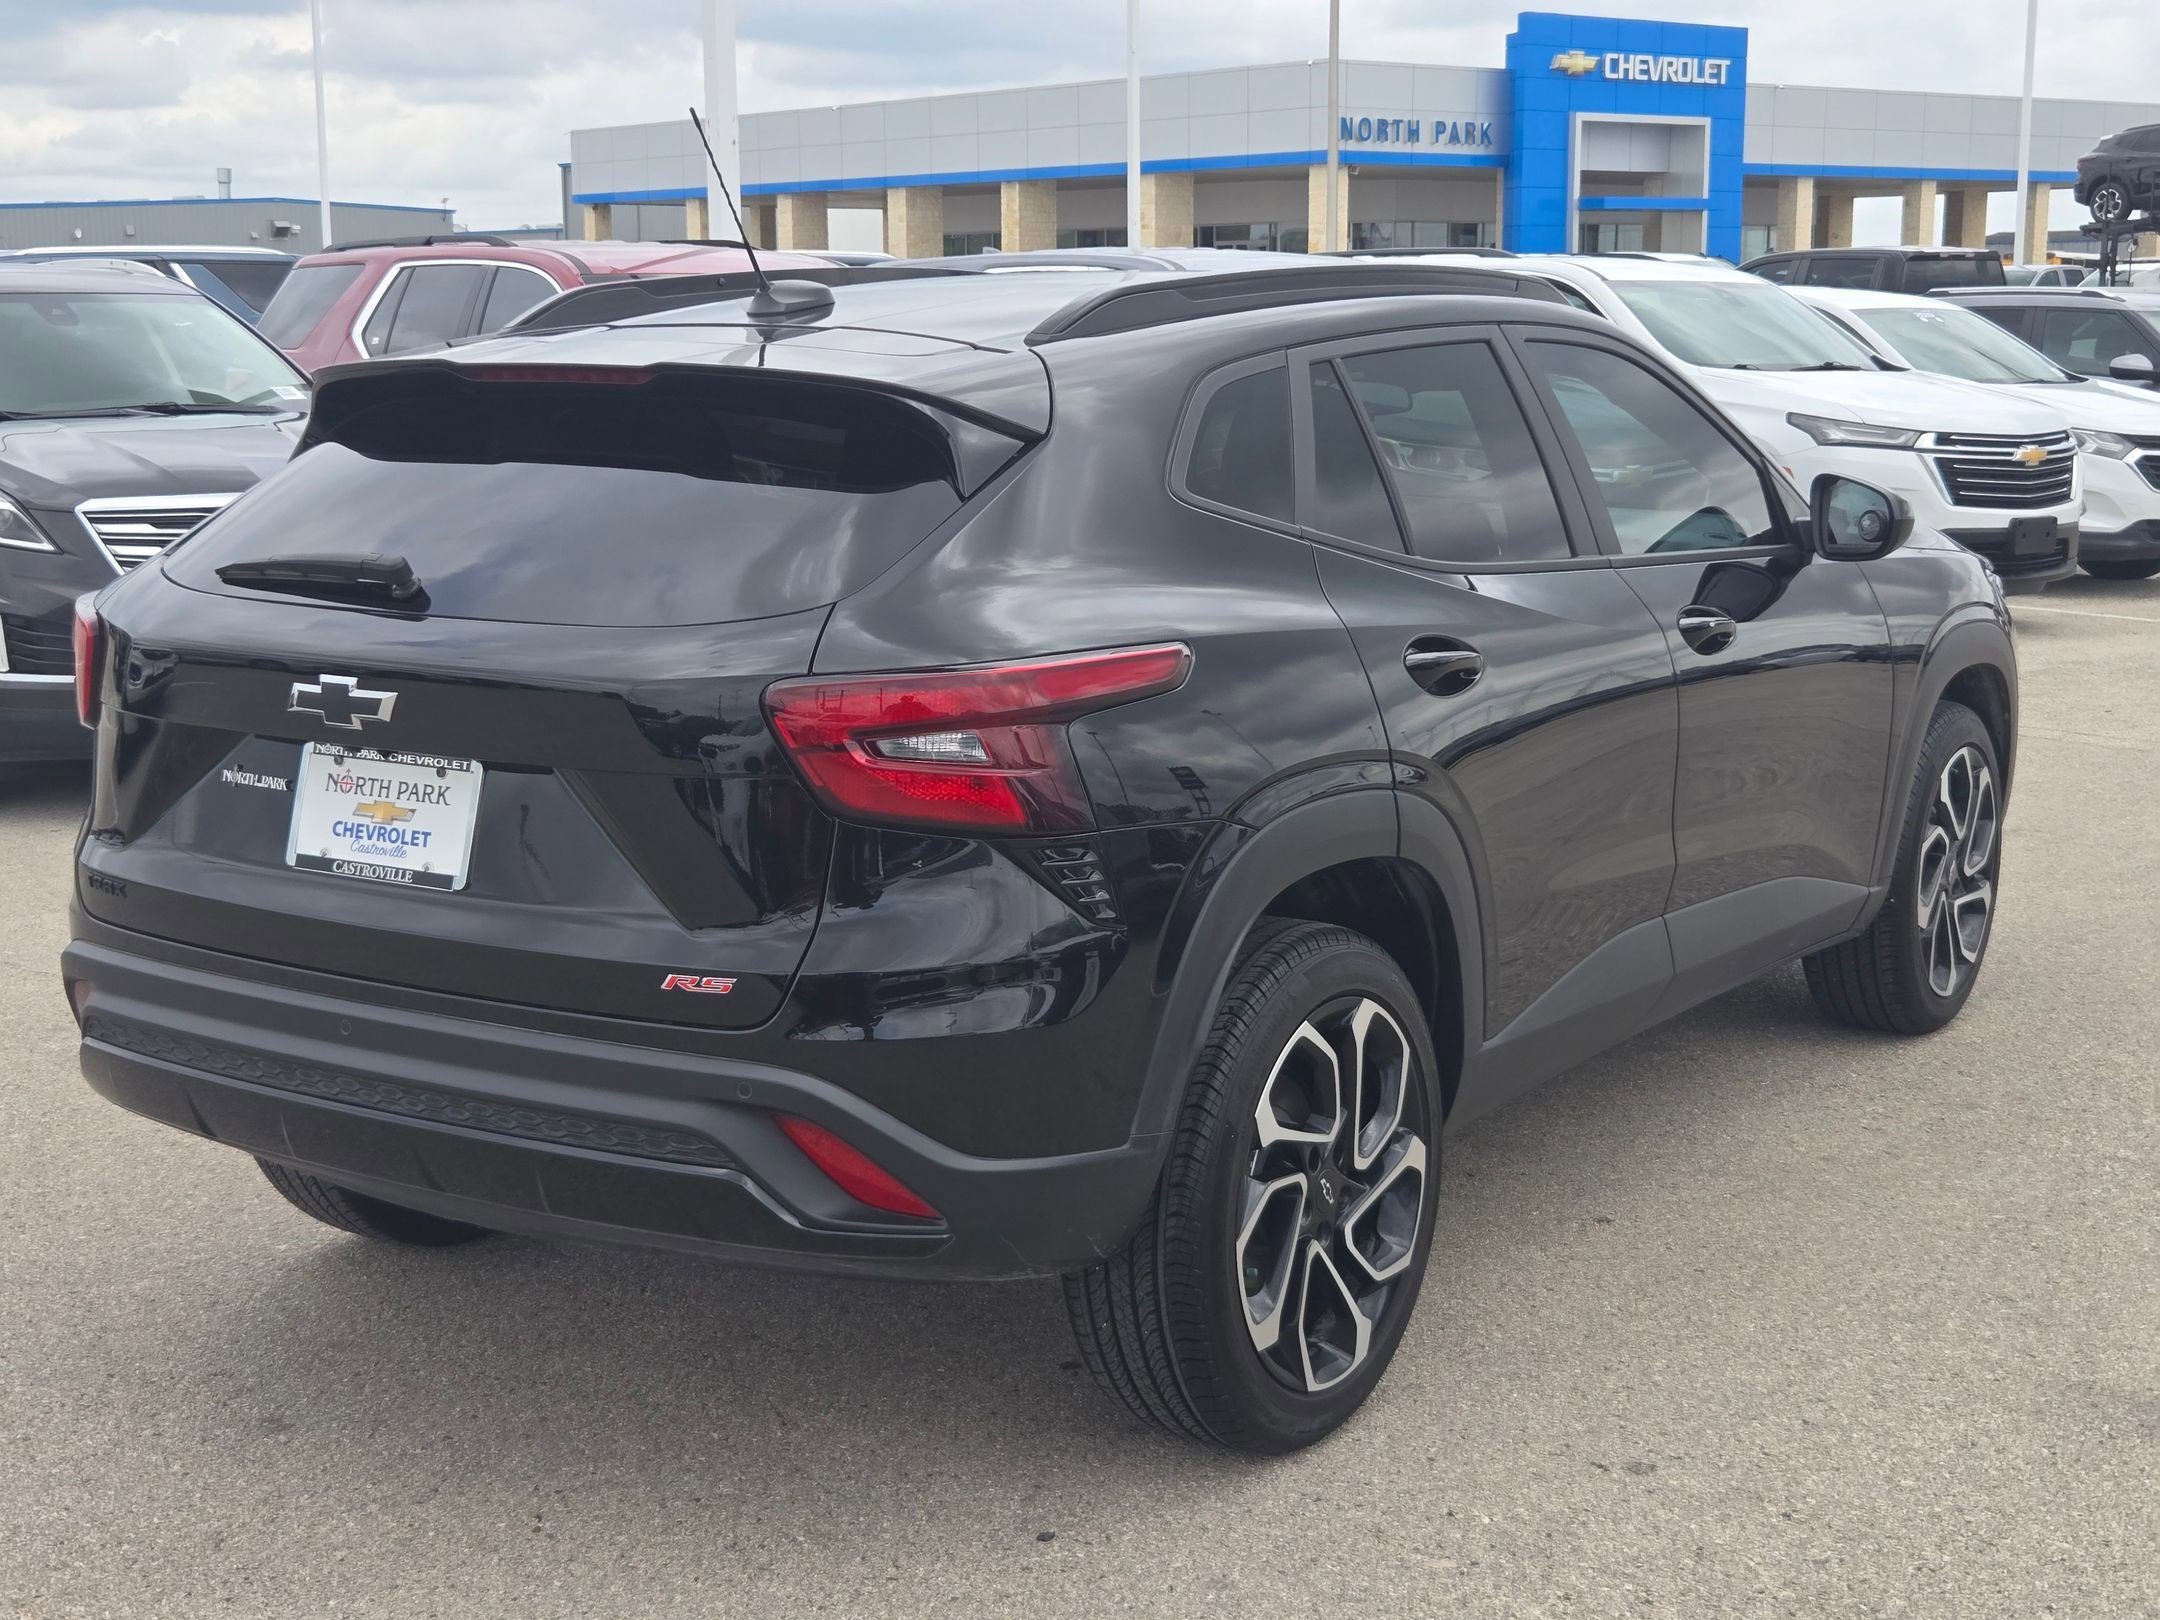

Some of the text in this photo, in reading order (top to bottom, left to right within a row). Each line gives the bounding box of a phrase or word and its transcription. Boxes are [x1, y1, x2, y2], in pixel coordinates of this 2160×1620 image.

[1604, 52, 1731, 85] CHEVROLET
[1340, 116, 1493, 146] NORTH PARK
[388, 752, 470, 771] CHEVROLET
[222, 767, 288, 791] NORTH PARK
[325, 771, 452, 806] NORTH PARK
[332, 820, 432, 848] CHEVROLET
[350, 839, 408, 859] Castroville
[332, 860, 413, 883] CASTROVILLE
[660, 973, 738, 994] RS
